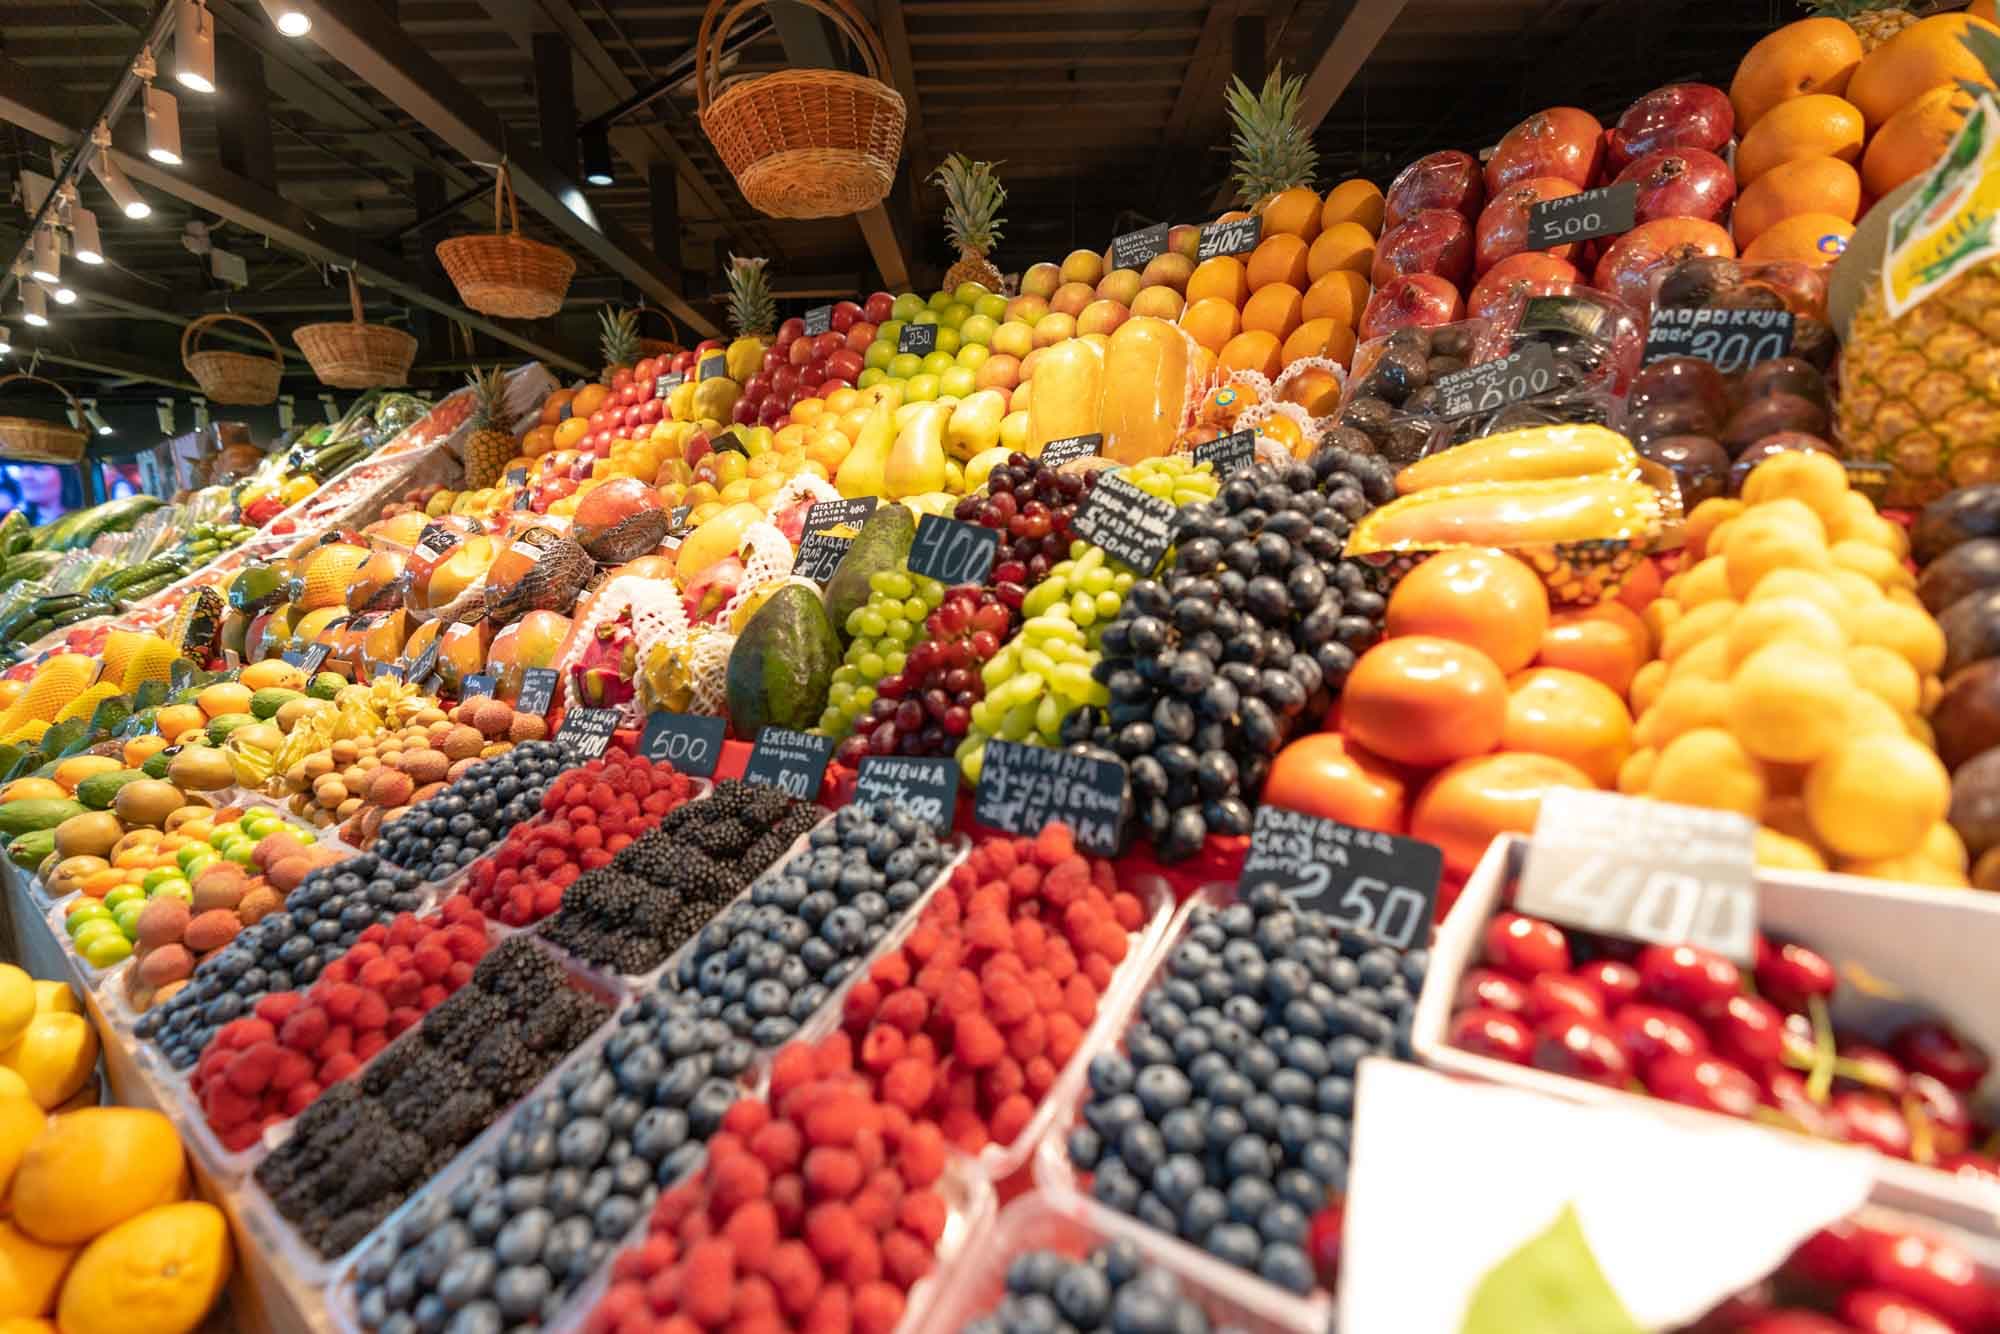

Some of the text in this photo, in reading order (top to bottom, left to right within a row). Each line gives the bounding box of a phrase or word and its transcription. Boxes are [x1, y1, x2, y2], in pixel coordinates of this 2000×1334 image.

[1541, 189, 1609, 214] ГРАНАТ
[922, 517, 995, 581] 400
[577, 732, 610, 757] 400
[762, 727, 825, 752] ЕЖЕВИКА
[986, 741, 1098, 784] МАЛИНА
[1001, 801, 1116, 849] СККА
[1280, 862, 1426, 949] 250
[1553, 850, 1755, 957] 400
